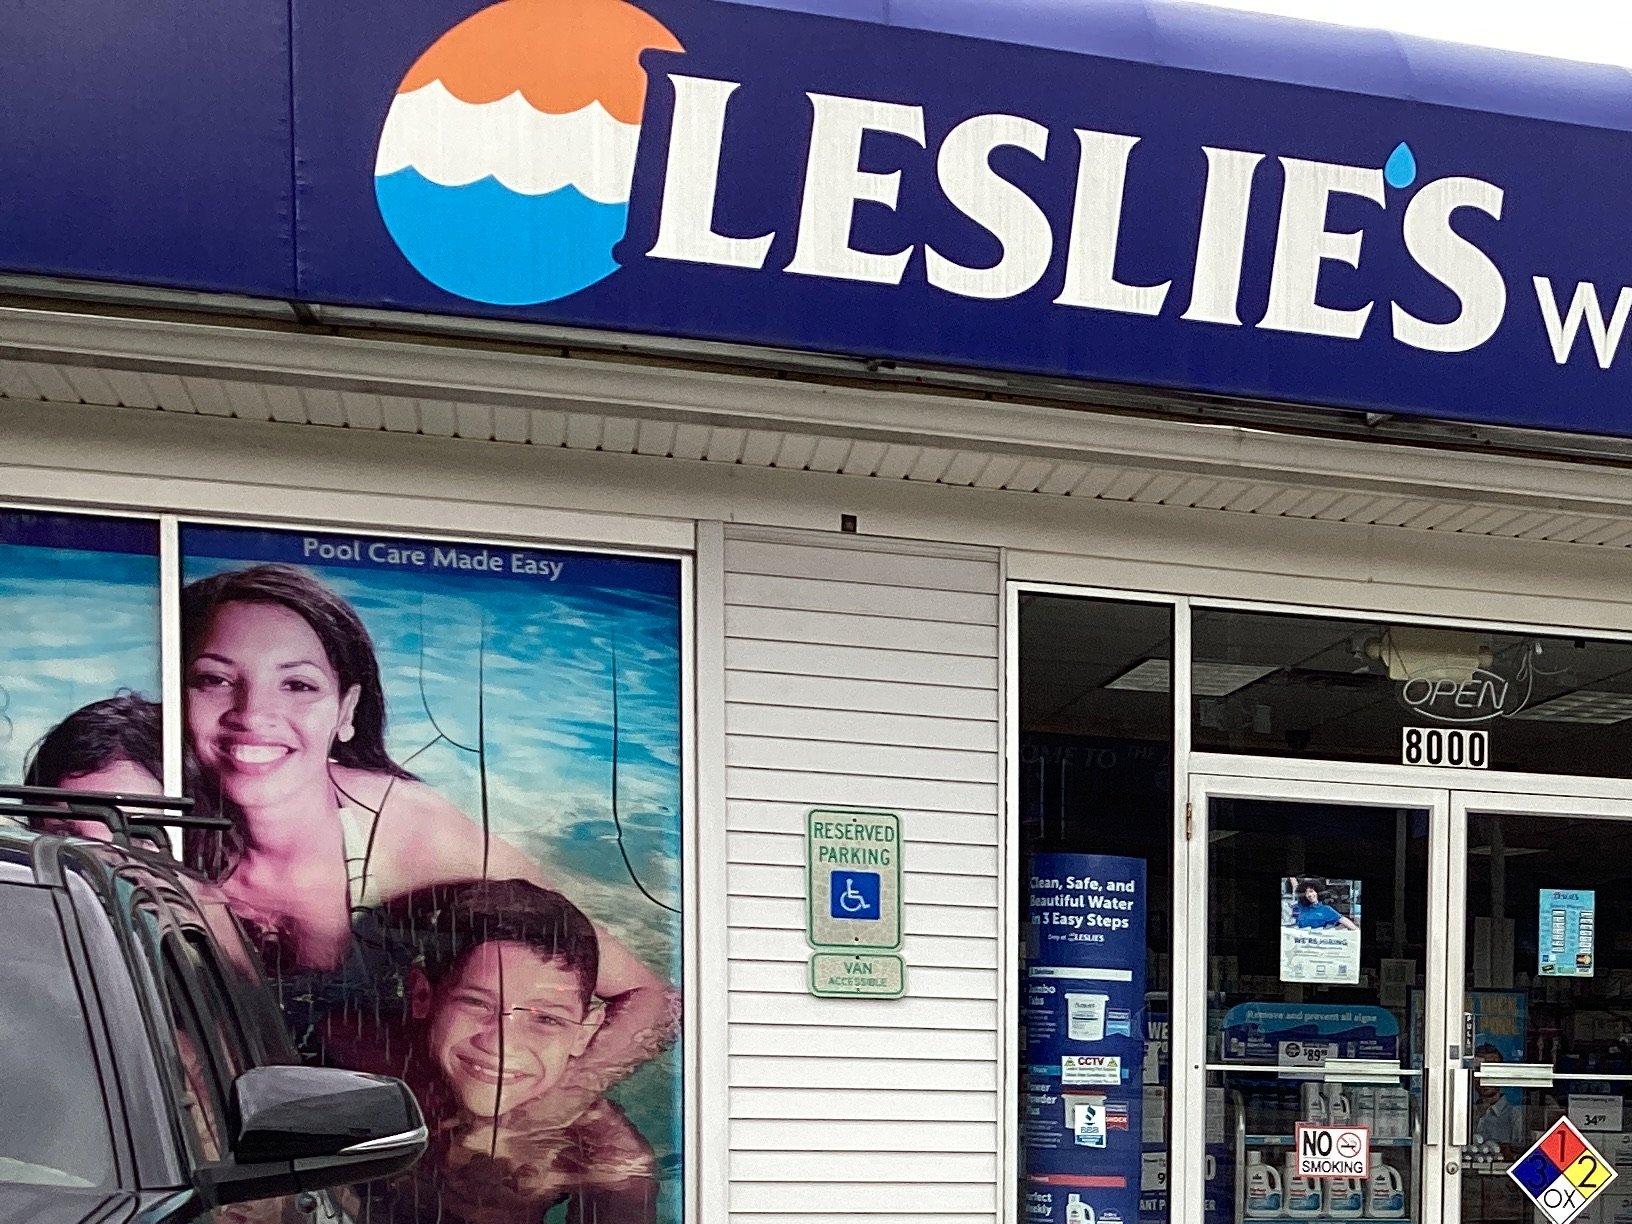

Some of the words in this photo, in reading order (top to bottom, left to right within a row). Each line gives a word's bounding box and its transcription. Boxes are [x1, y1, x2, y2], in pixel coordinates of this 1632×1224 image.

[303, 537, 360, 561] Pool
[368, 543, 425, 566] Care
[433, 547, 503, 572] Made
[511, 554, 563, 580] Easy
[1403, 677, 1508, 710] OPEN
[1405, 728, 1485, 767] 8000
[813, 821, 895, 843] RESERVED
[819, 845, 891, 866] PARKING
[1066, 876, 1103, 892] Safe,
[1106, 880, 1136, 893] and
[1030, 894, 1085, 908] Beautiful
[1088, 895, 1134, 911] Water
[1042, 912, 1050, 925] 3
[1052, 912, 1083, 929] Easy
[1087, 913, 1130, 931] Steps
[844, 962, 873, 975] VAN
[827, 976, 889, 988] ACCESSIBLE
[1077, 1057, 1105, 1066] CCTV
[1302, 1130, 1333, 1157] NO
[1557, 1130, 1567, 1163] 1
[1302, 1160, 1363, 1174] SMOKING
[1530, 1154, 1548, 1189] 3
[1577, 1155, 1597, 1188] 2
[1543, 1188, 1576, 1209] OX
